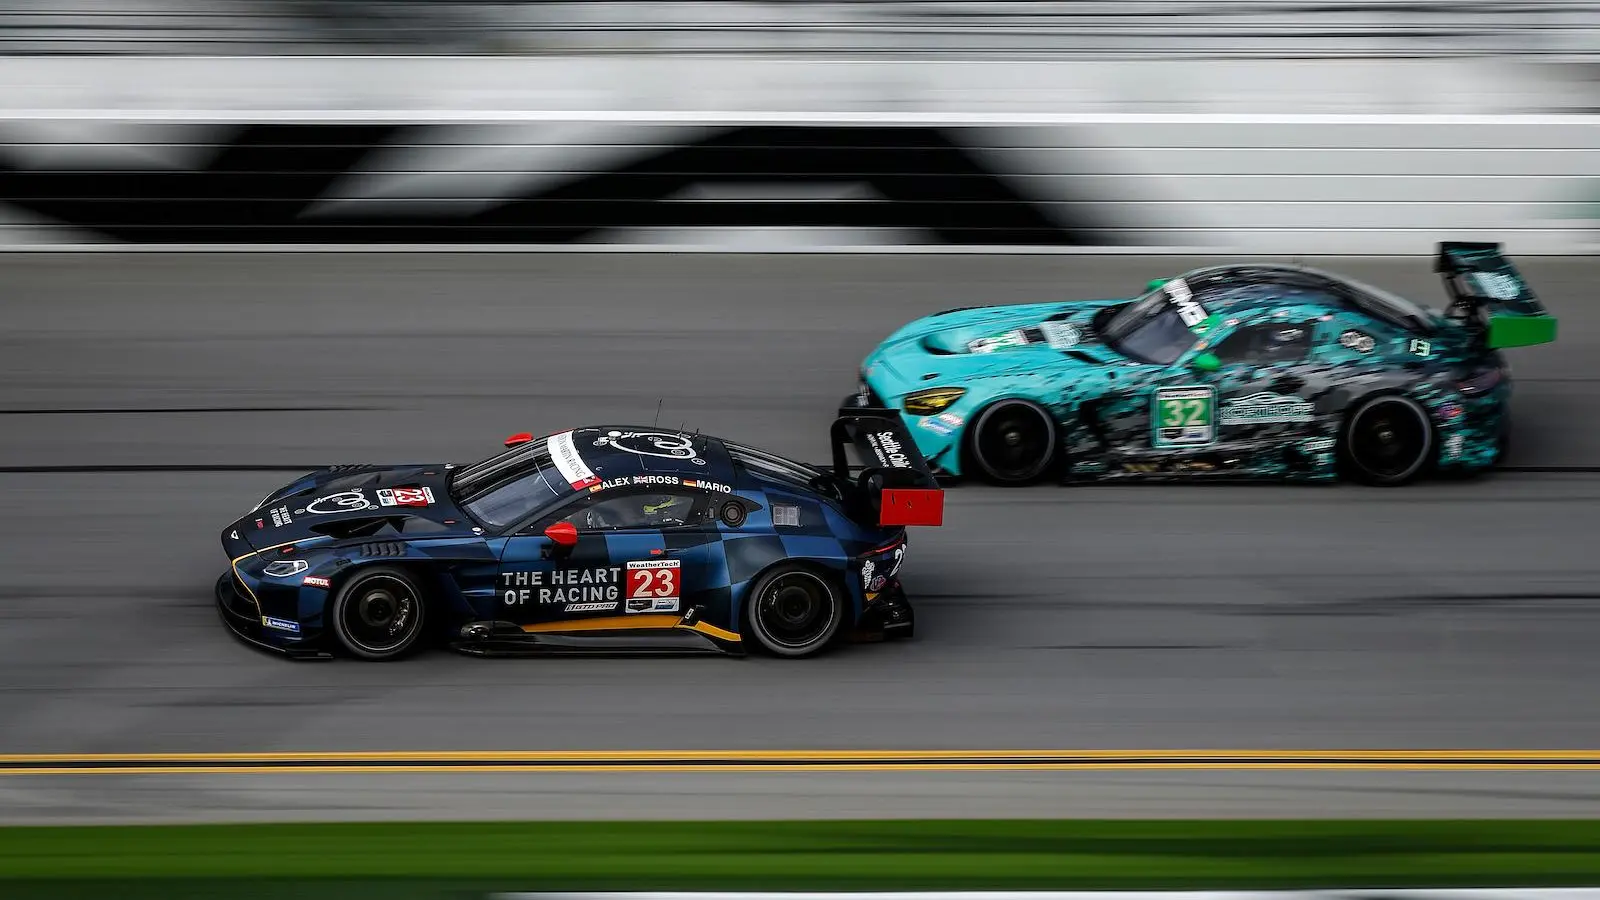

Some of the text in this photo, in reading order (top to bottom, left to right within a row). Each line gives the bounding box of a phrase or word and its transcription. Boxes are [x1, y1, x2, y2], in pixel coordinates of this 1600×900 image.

[1164, 400, 1207, 426] 32
[877, 431, 901, 454] Seattle
[602, 477, 630, 490] ALEX
[648, 475, 679, 485] ROSS
[696, 480, 732, 494] MARIO
[395, 489, 425, 503] 23
[628, 561, 679, 569] WeatherTech
[303, 576, 329, 586] MOTUL
[502, 567, 621, 586] THE HEART
[633, 569, 674, 598] 23
[504, 585, 619, 605] OF RACING
